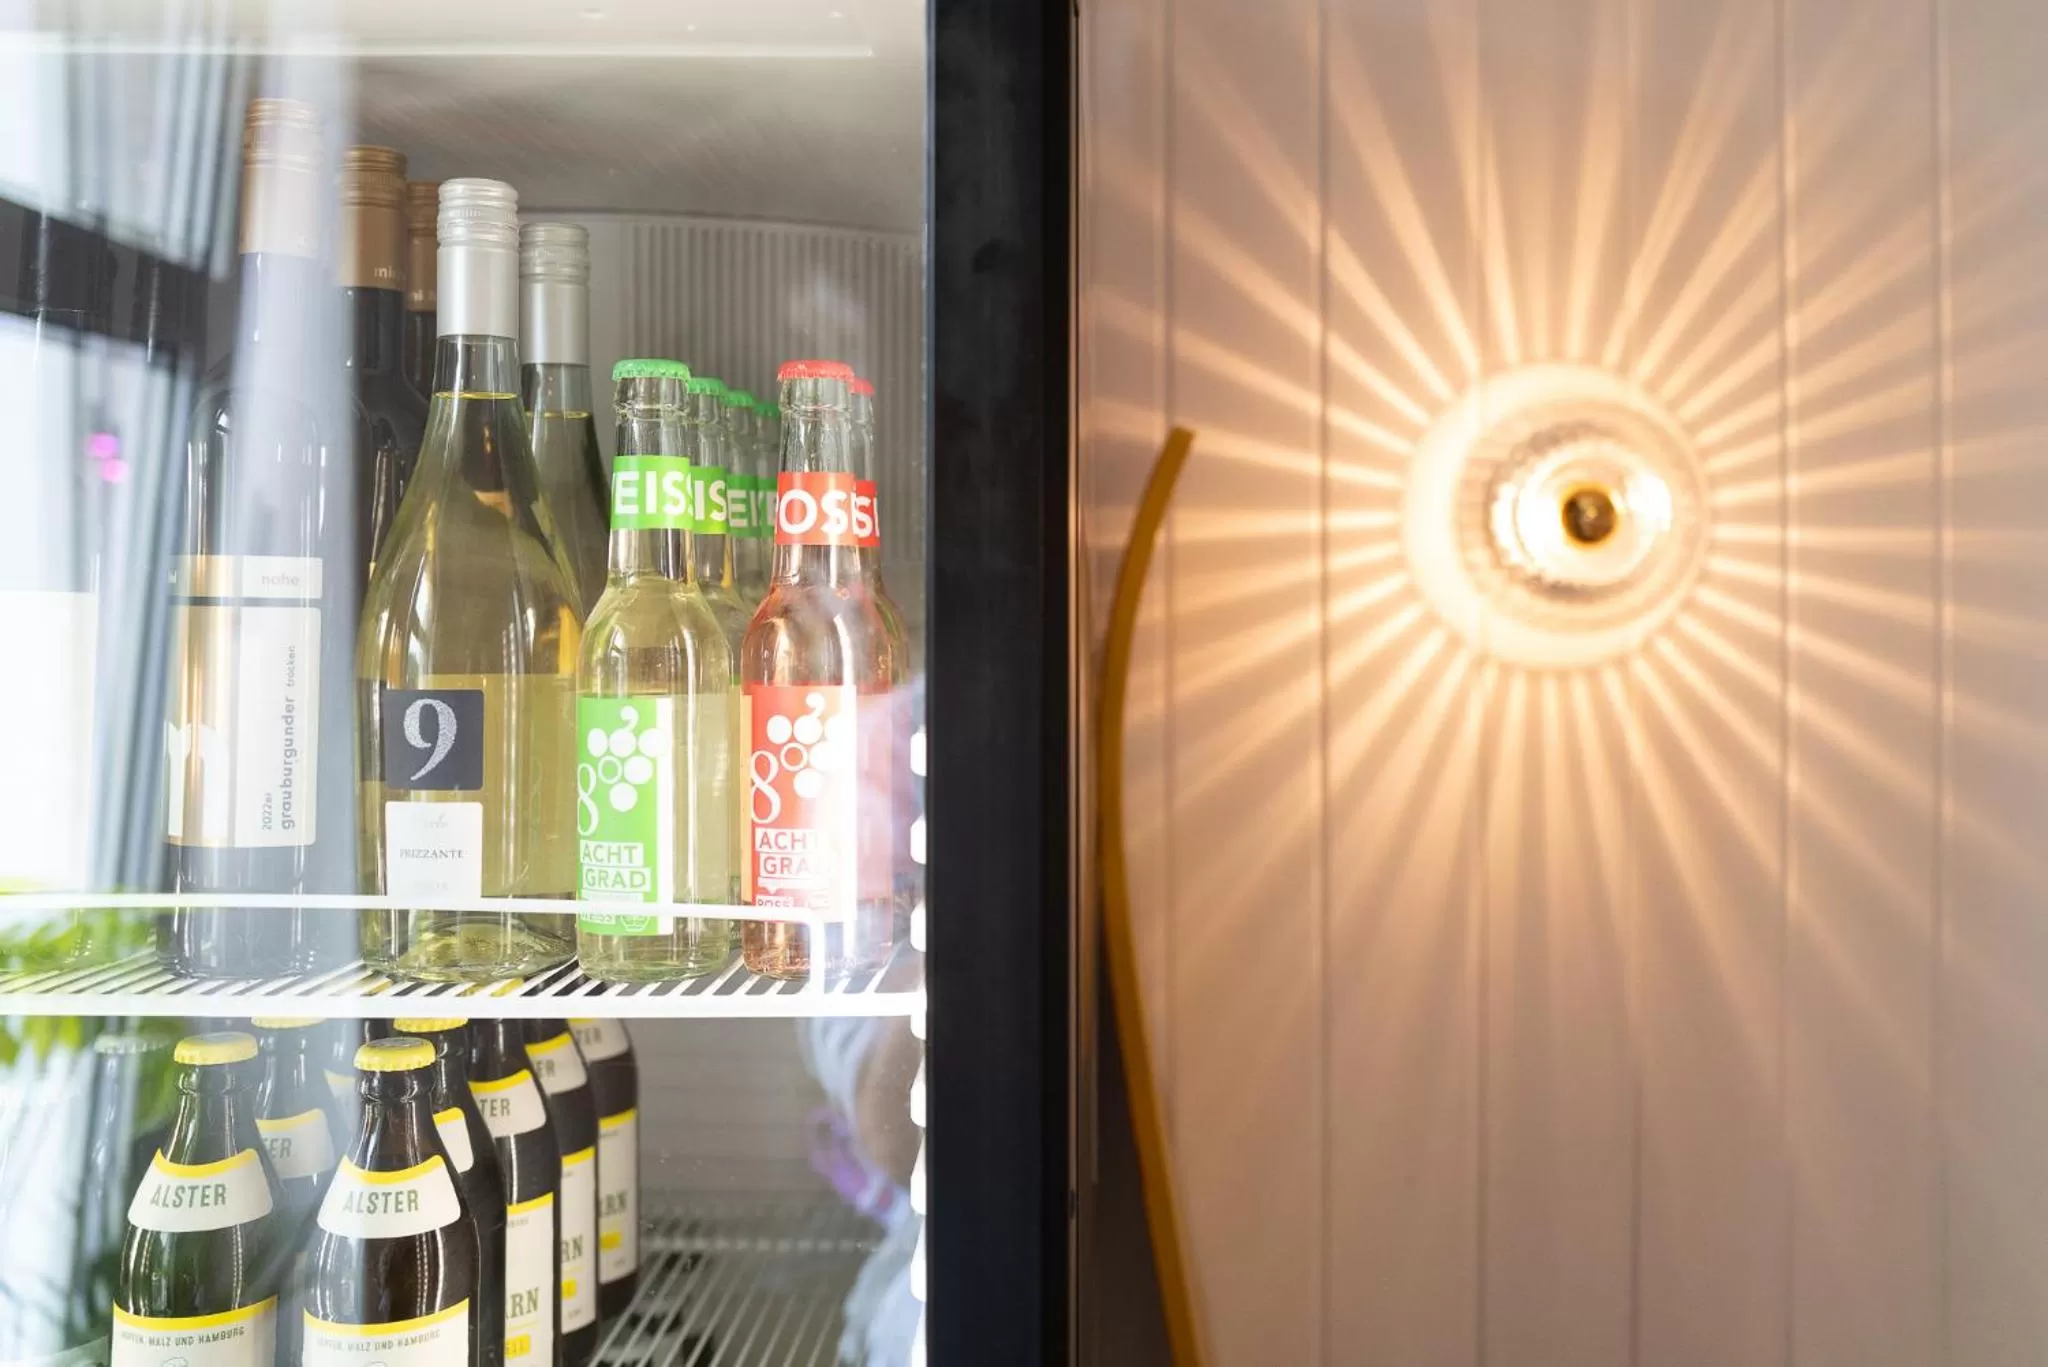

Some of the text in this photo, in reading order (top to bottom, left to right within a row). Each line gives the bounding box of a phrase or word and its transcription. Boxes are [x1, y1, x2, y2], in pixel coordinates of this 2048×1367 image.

[403, 698, 458, 781] 9
[279, 696, 297, 831] grauburgunder
[400, 849, 464, 859] FRIZZANTE
[582, 843, 638, 864] ACHT
[763, 855, 822, 875] GRA
[585, 868, 646, 889] GRAD
[150, 1184, 227, 1208] ALSTER
[342, 1189, 420, 1214] ALSTER
[505, 1287, 540, 1319] RN
[149, 1335, 171, 1347] MALZ
[175, 1335, 195, 1347] UND
[198, 1326, 245, 1344] HAMBURG
